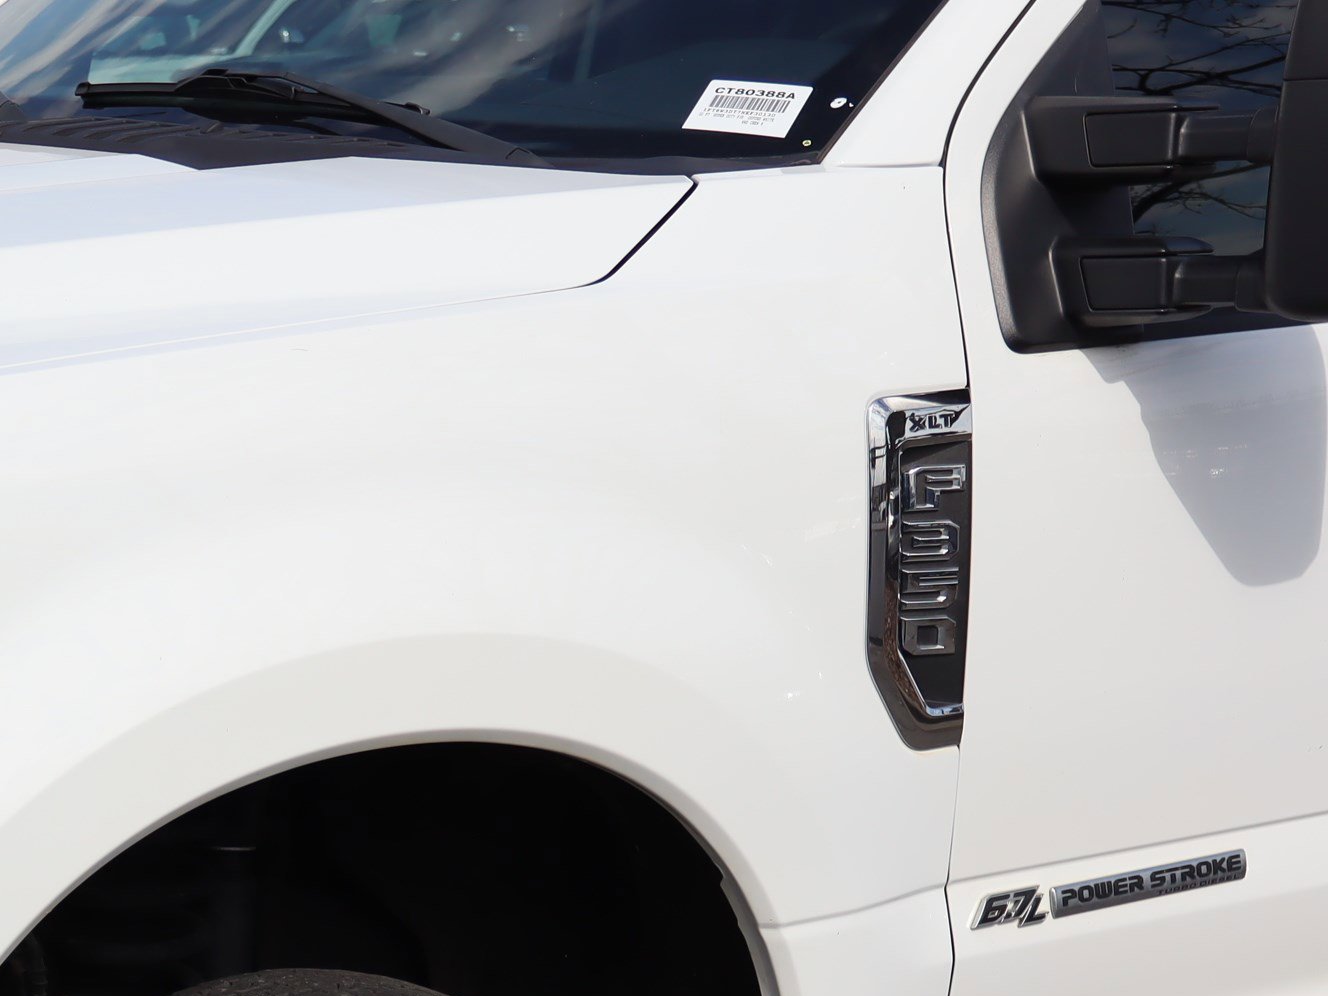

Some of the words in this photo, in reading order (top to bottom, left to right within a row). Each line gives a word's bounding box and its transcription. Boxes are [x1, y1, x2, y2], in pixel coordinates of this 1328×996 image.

[715, 87, 795, 99] CT80388A
[908, 412, 953, 432] XLT
[1061, 875, 1145, 907] POWER
[1150, 854, 1242, 889] STROKE
